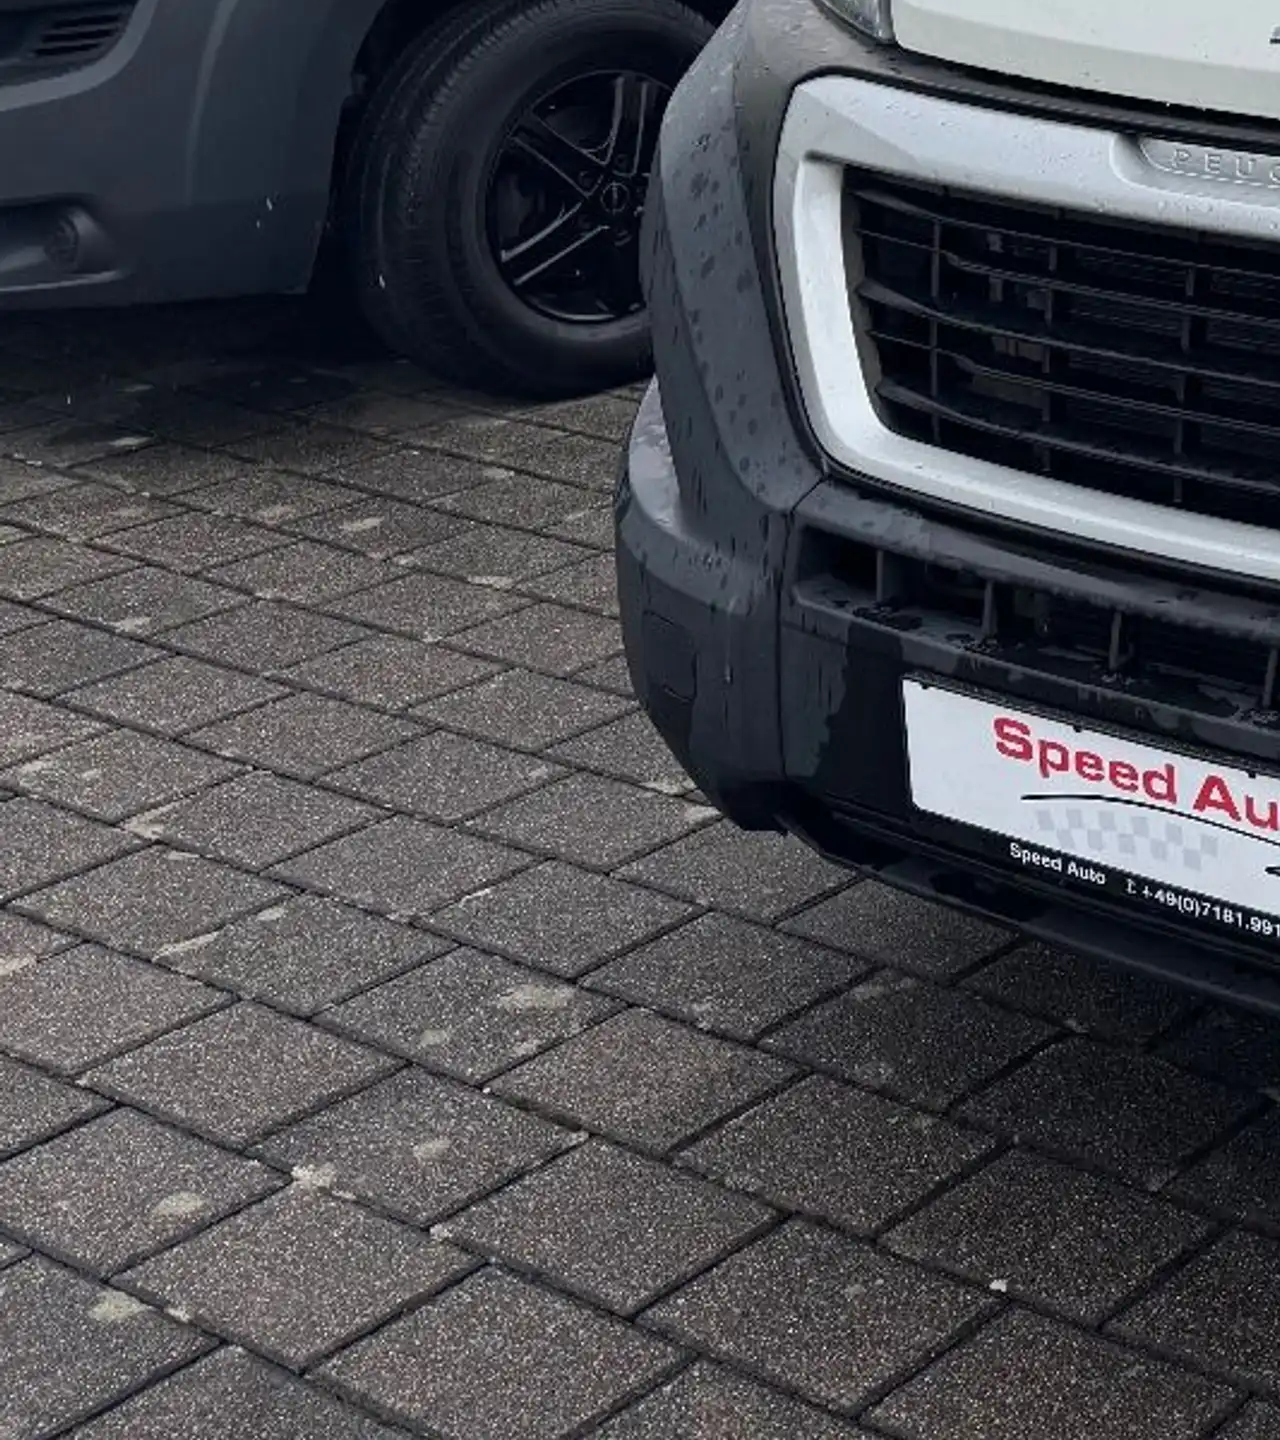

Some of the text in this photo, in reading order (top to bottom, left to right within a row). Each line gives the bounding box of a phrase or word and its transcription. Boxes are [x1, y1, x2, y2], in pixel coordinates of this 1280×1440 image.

[993, 717, 1177, 805] Speed
[1009, 842, 1062, 873] Speed
[1067, 864, 1106, 885] Auto
